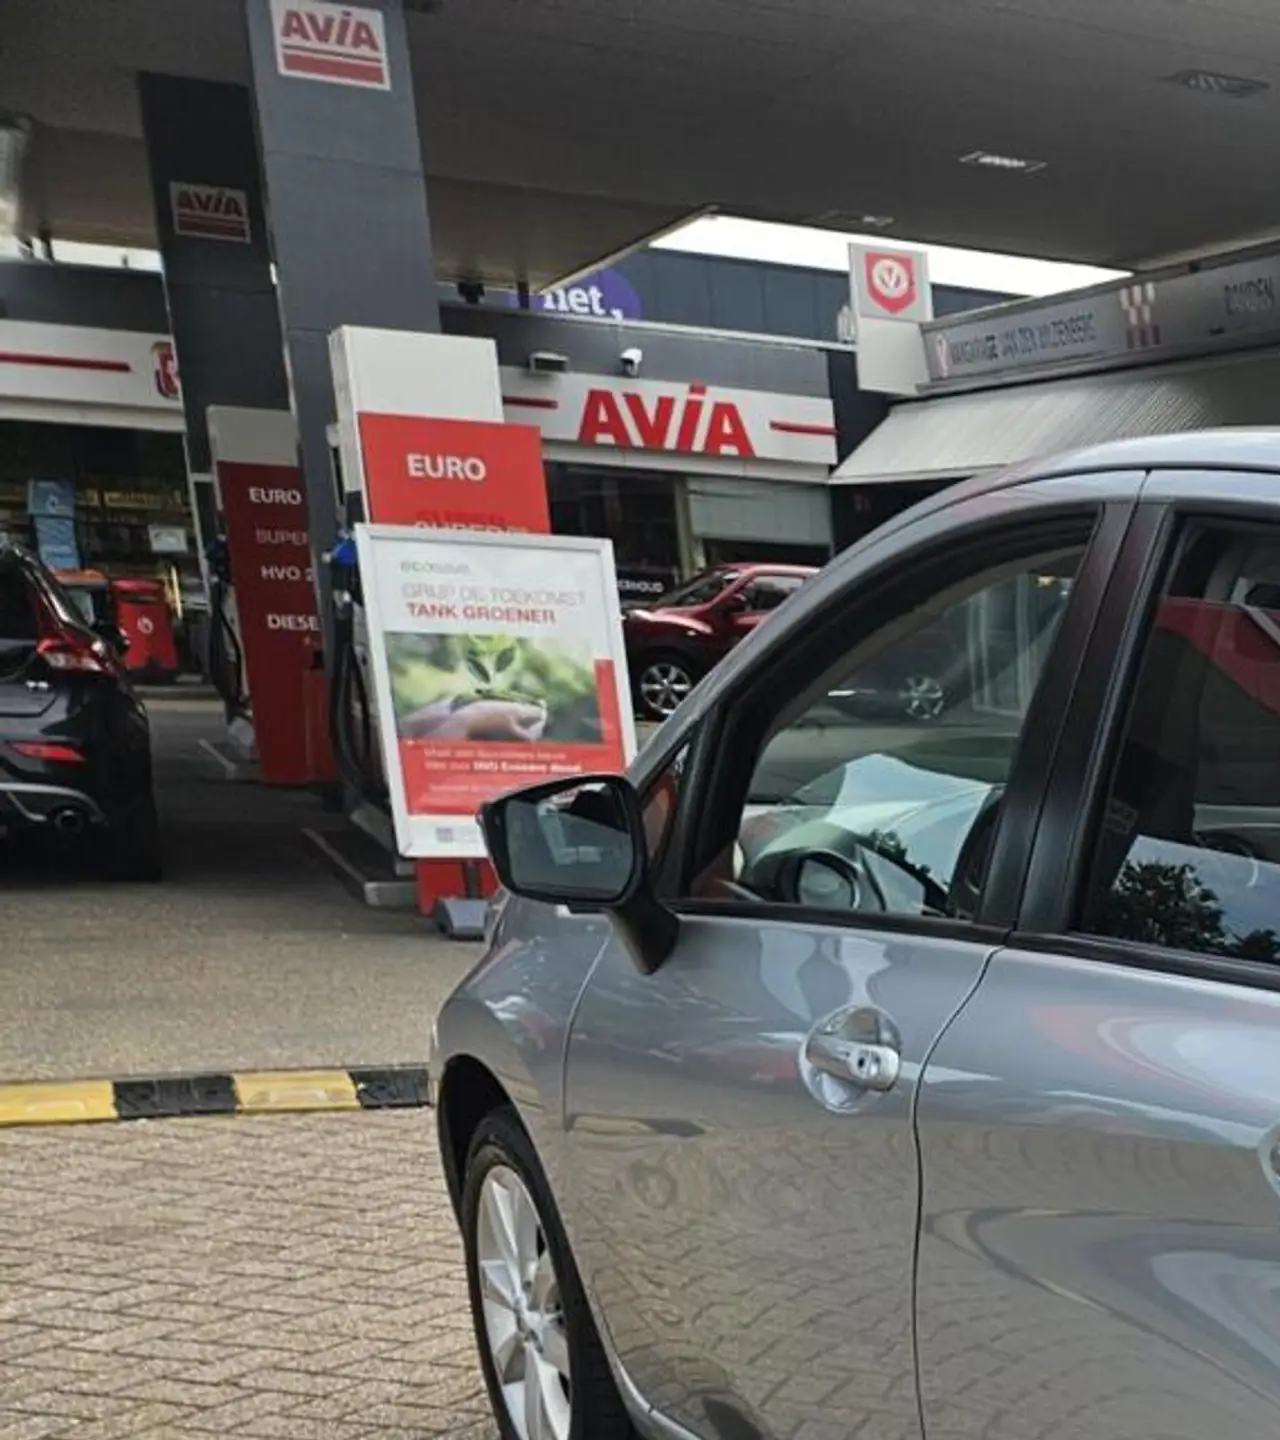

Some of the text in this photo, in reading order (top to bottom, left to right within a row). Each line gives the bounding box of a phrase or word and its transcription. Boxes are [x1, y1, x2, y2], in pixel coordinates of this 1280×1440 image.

[280, 10, 380, 52] AVIA
[177, 187, 244, 218] AVIA
[577, 384, 756, 457] AVIA
[406, 454, 486, 482] EURO
[249, 487, 302, 505] EURO
[260, 566, 301, 582] HVO
[267, 613, 321, 631] DIESE
[407, 602, 556, 624] TANK GROENER
